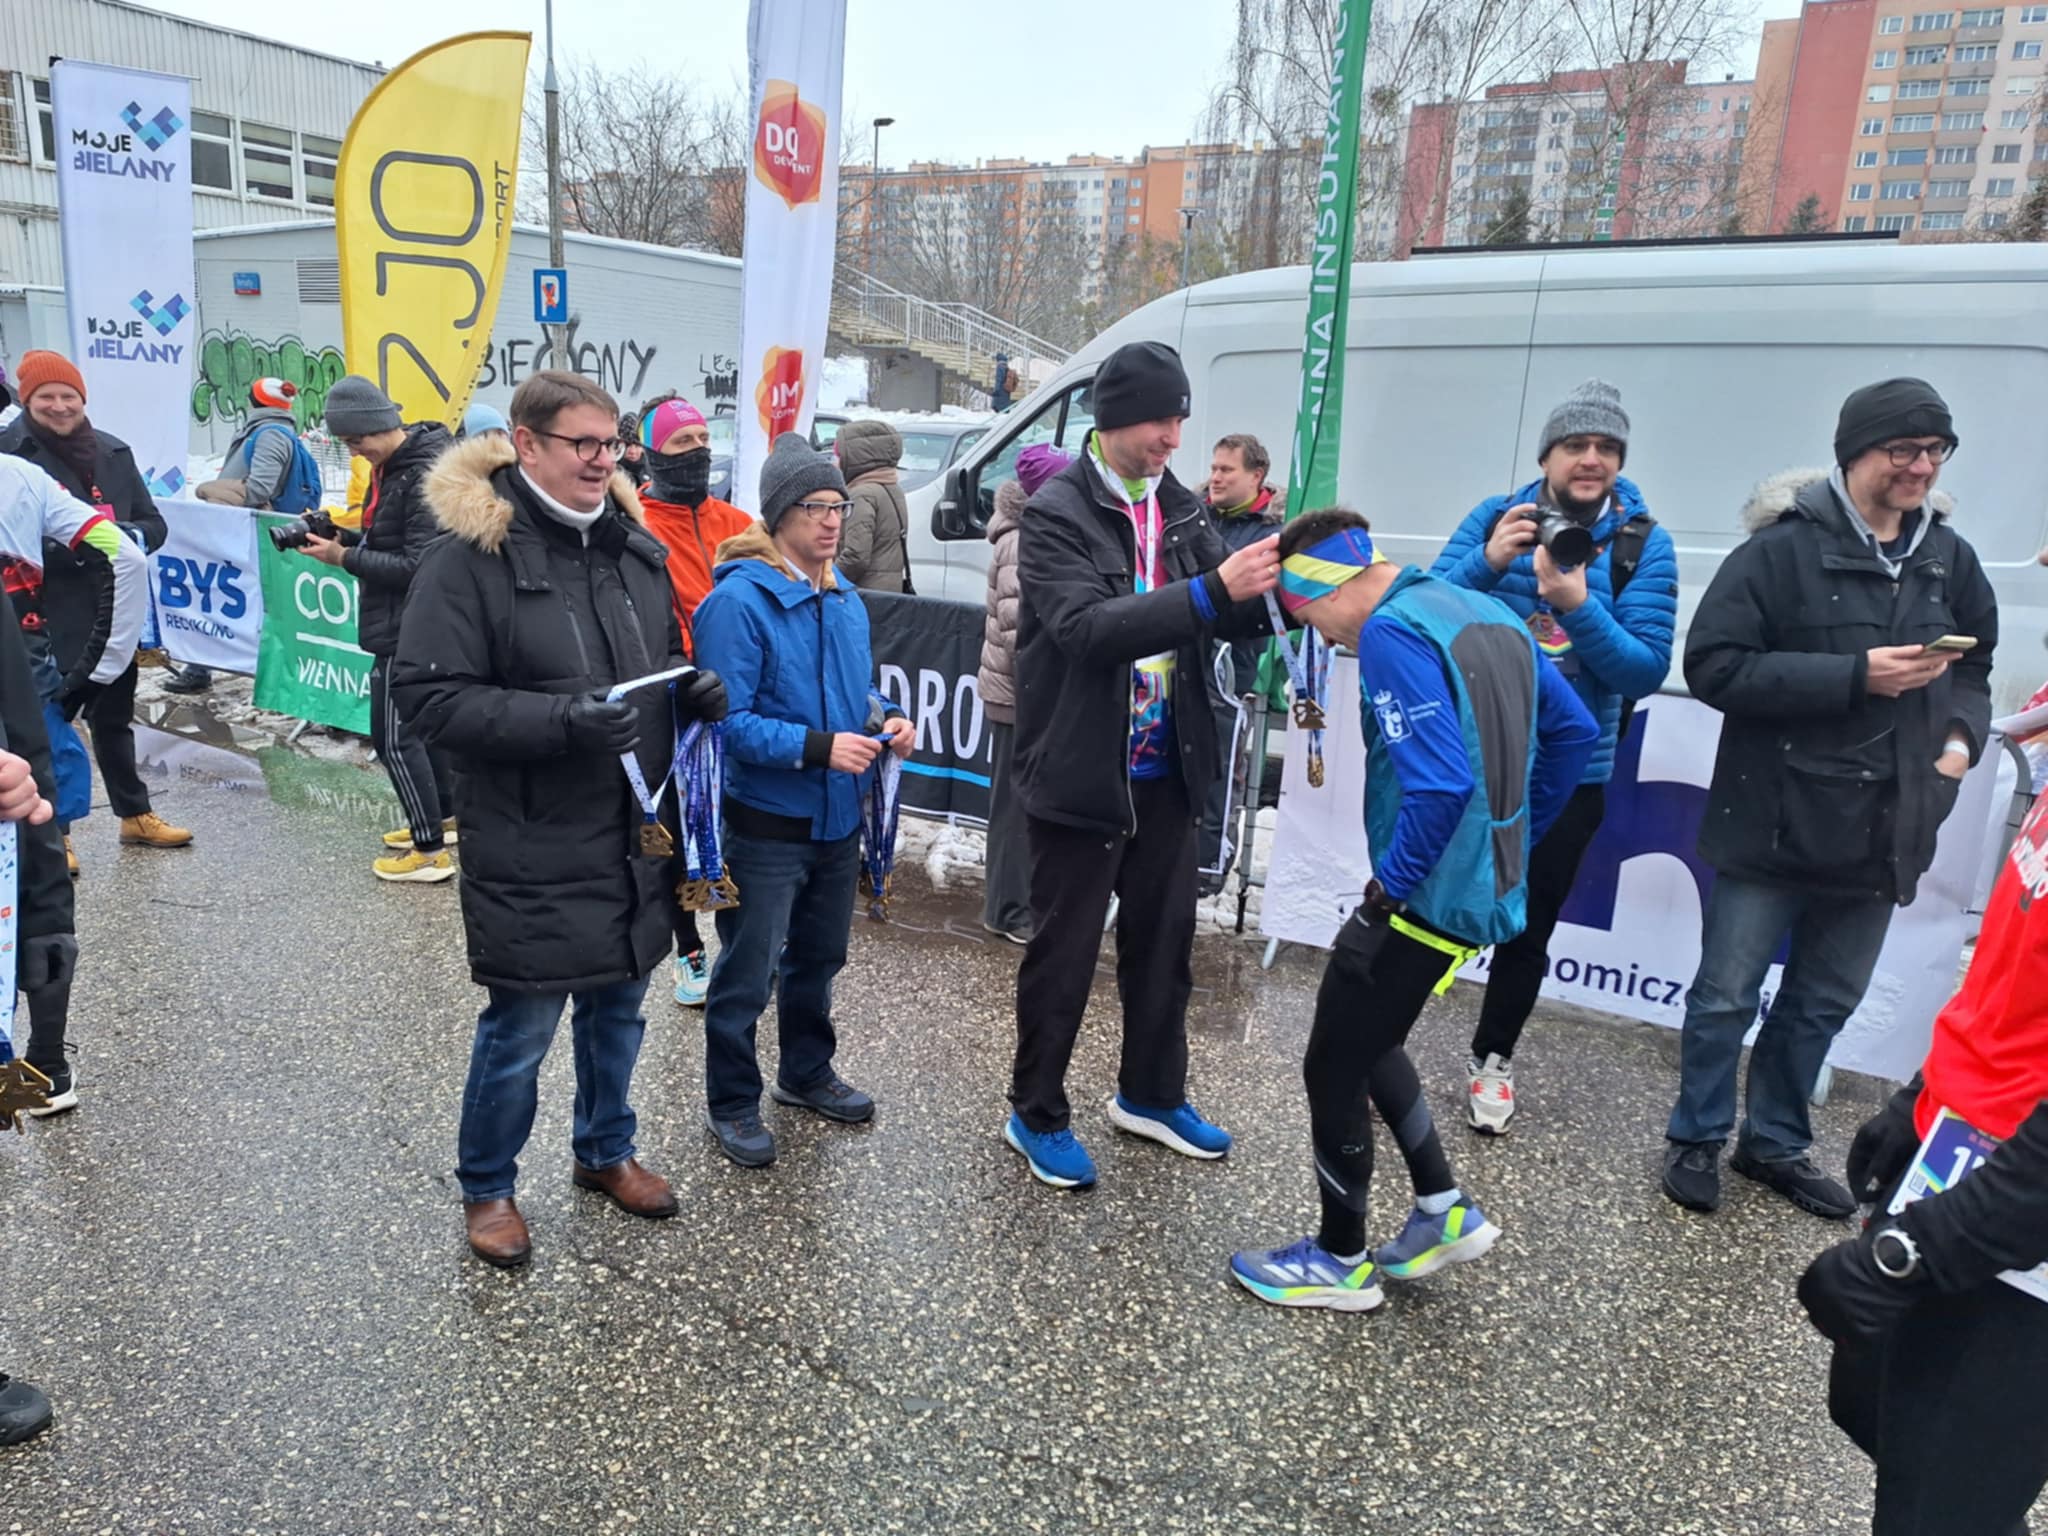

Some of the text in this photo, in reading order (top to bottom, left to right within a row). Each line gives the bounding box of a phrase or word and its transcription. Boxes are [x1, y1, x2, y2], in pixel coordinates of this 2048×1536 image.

[72, 128, 132, 153] MOJE
[1311, 0, 1347, 293] INSURANC
[73, 149, 176, 182] BIELANY
[294, 571, 361, 629] CO
[165, 613, 235, 641] RECYKLING
[297, 656, 372, 699] VIENNA
[879, 663, 994, 764] DRO
[1543, 956, 1684, 1007] omicz
